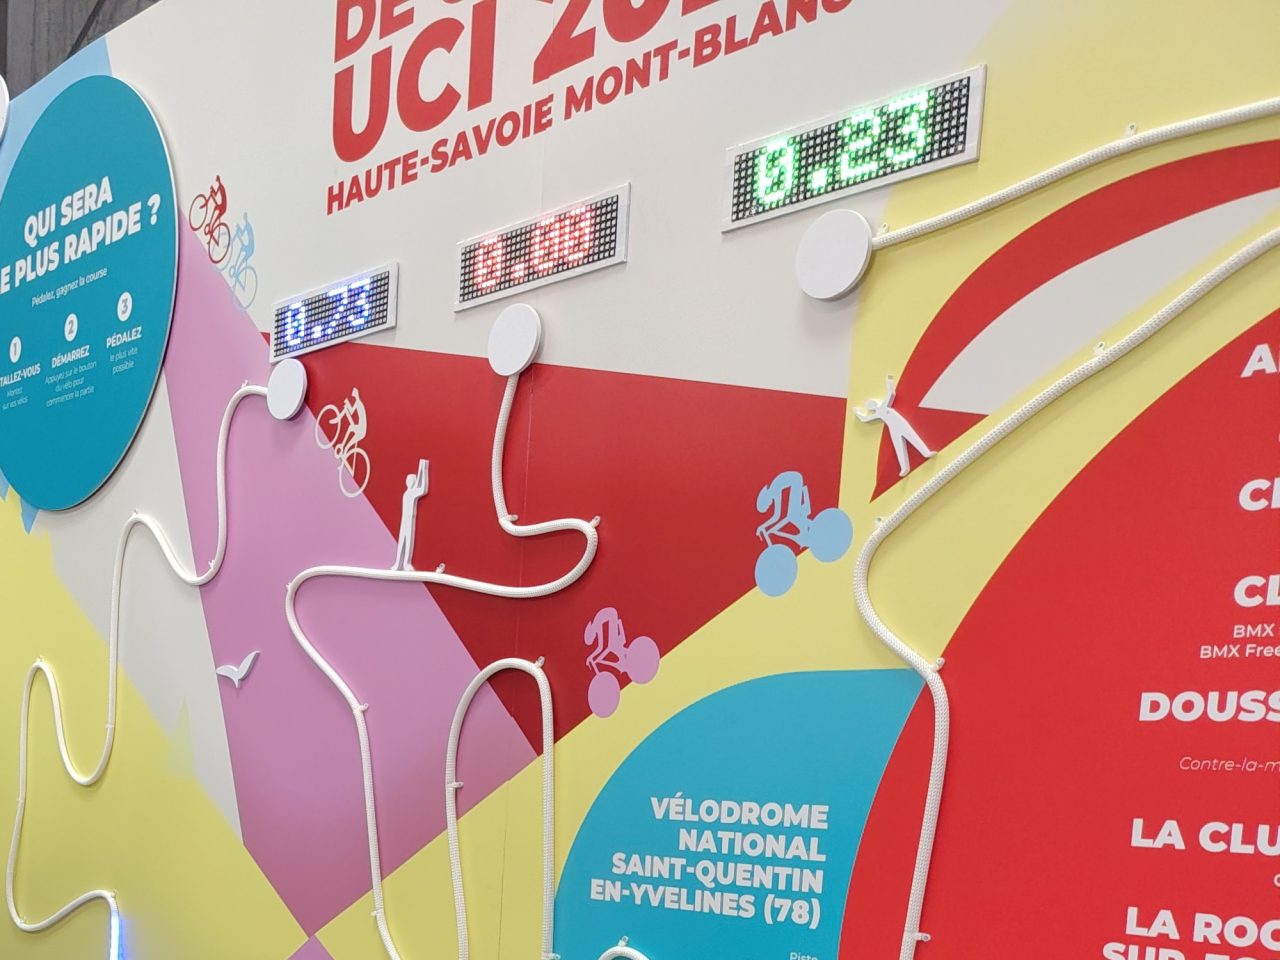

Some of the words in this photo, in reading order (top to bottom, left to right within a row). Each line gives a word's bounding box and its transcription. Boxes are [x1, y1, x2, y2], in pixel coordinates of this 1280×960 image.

[332, 0, 497, 163] UCI
[327, 93, 554, 216] HAUTE-SAVOIE
[24, 204, 56, 248] QUI
[60, 176, 113, 226] SERA
[14, 241, 59, 288] PLUS
[64, 201, 142, 264] RAPIDE
[147, 193, 161, 225] ?
[477, 205, 591, 288] 0.00
[56, 280, 78, 299] gagnez
[79, 276, 85, 286] la
[86, 268, 108, 284] course
[106, 326, 142, 348] PÉDALEZ
[51, 345, 90, 368] DÉMARREZ
[1240, 343, 1280, 378] A
[1233, 623, 1275, 638] BMX
[1199, 644, 1240, 659] BMX
[1179, 756, 1280, 773] Contre-la-m
[650, 792, 829, 830] VÉLODROME
[678, 828, 827, 862] NATIONAL
[1131, 818, 1186, 850] LA
[1199, 821, 1280, 856] CLU
[611, 852, 824, 894] SAINT-QUENTIN
[590, 878, 756, 919] EN-YVELINES
[764, 894, 821, 930] (78)
[1126, 906, 1180, 940] LA
